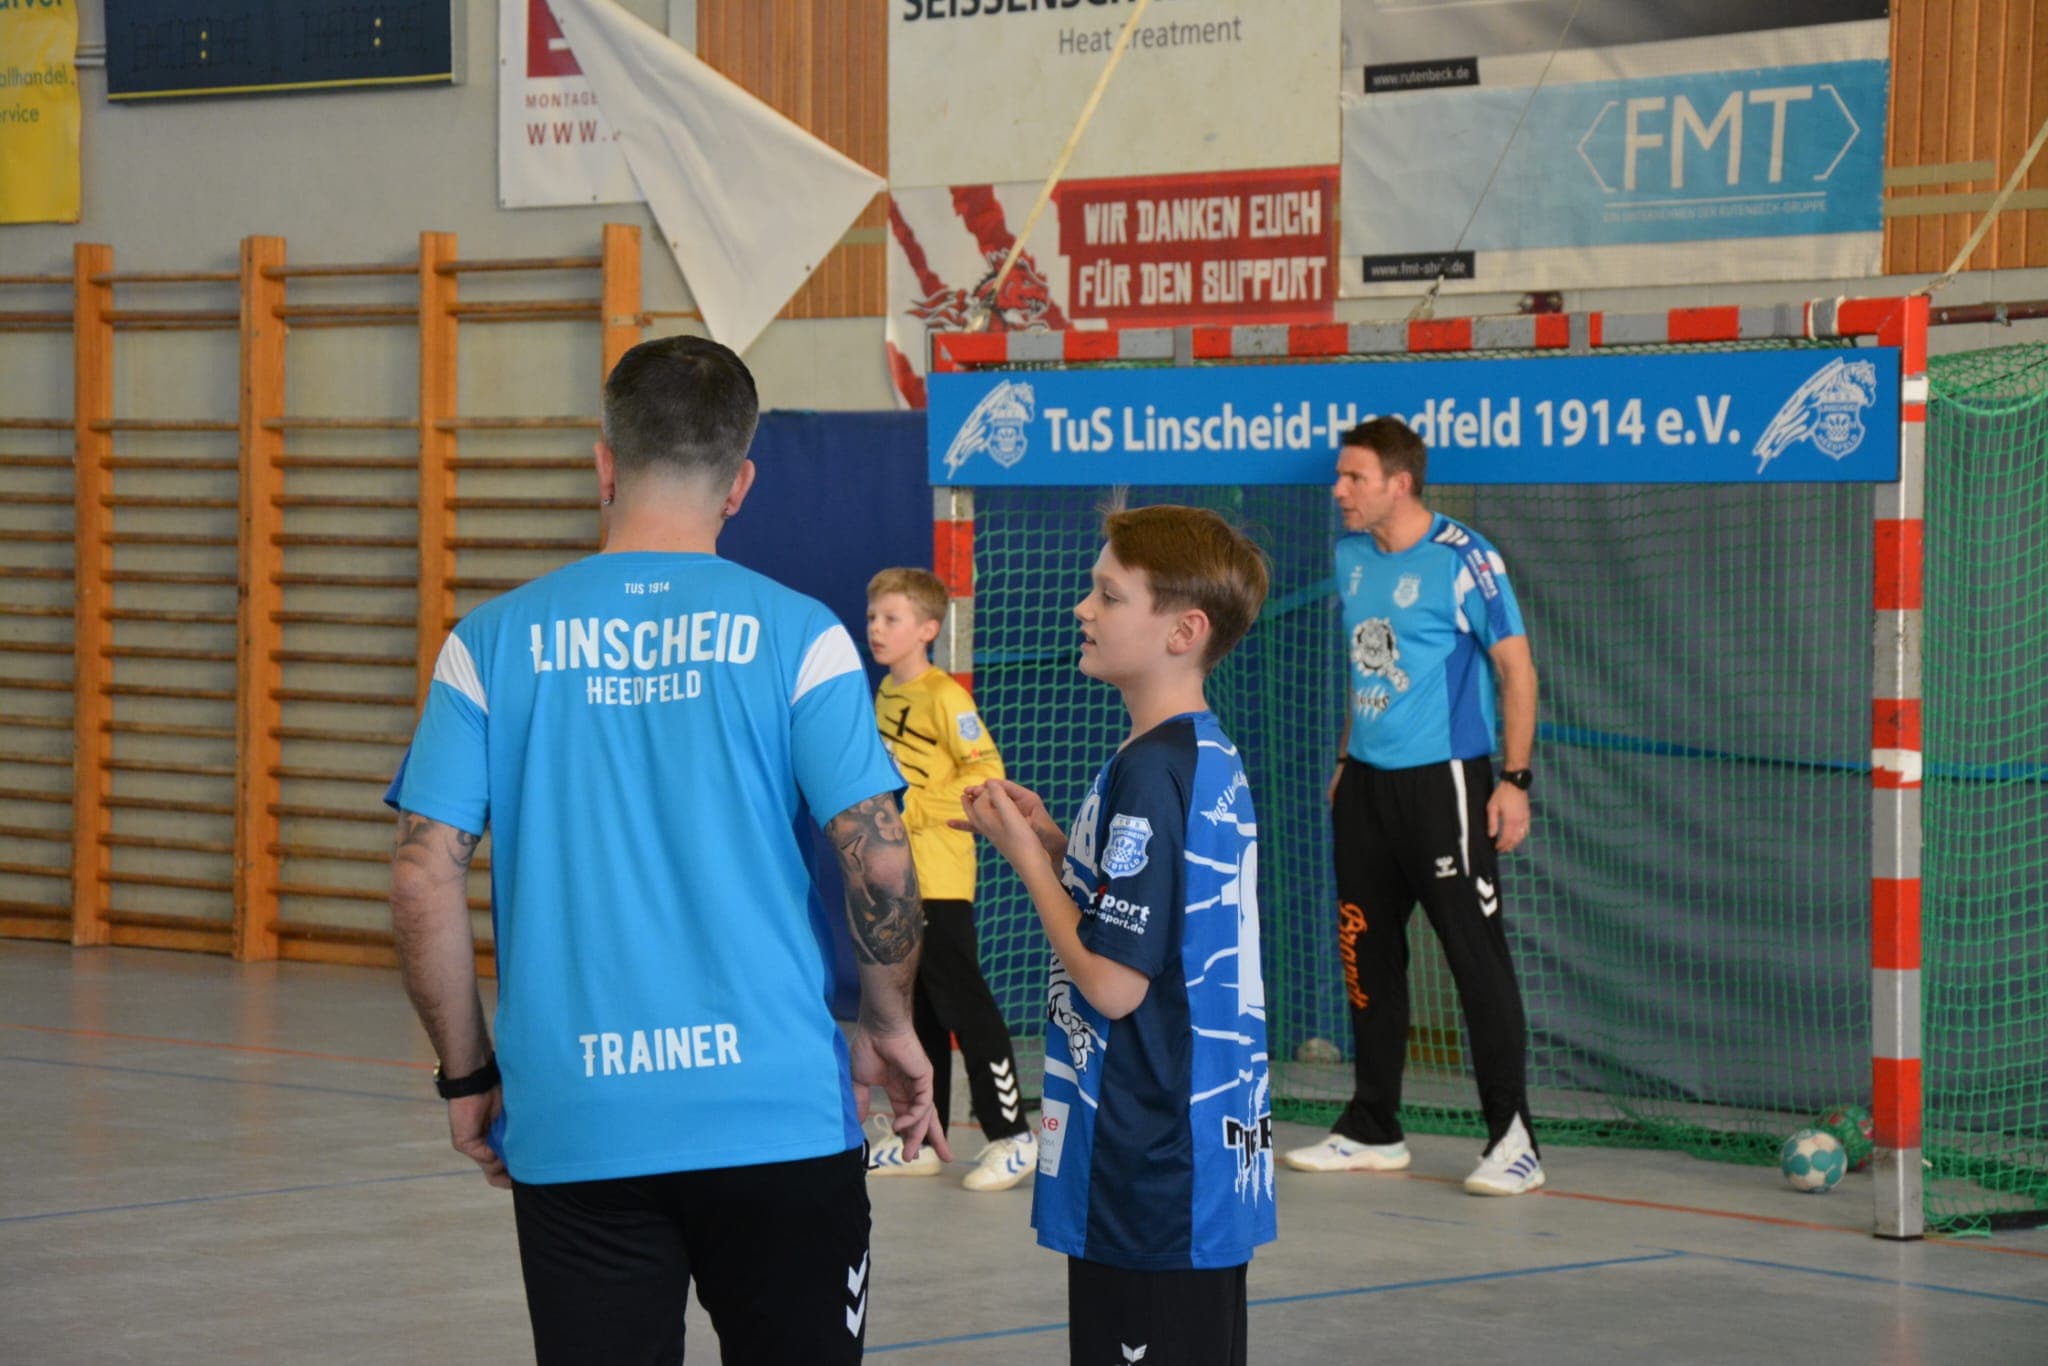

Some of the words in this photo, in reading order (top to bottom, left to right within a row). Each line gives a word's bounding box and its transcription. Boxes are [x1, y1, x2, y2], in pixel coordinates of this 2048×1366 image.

[1058, 27, 1112, 55] Heat
[1624, 85, 1813, 191] FMT
[1084, 202, 1127, 245] WIR
[1137, 196, 1240, 243] DANKEN
[1249, 190, 1321, 239] EUCH
[1079, 258, 1131, 307] FÜR
[1140, 262, 1192, 305] DEN
[1202, 256, 1327, 303] SUPPORT
[1044, 407, 1114, 452] TuS
[1123, 397, 1520, 451] Linscheid-Hdfeld
[1536, 398, 1645, 447] 1914
[1656, 395, 1741, 445] e.V.
[624, 582, 644, 594] TUS
[649, 581, 671, 593] 1914
[529, 611, 760, 674] LINSCHEID
[586, 669, 701, 706] HEEDFELD
[579, 1023, 742, 1078] TRAINER
